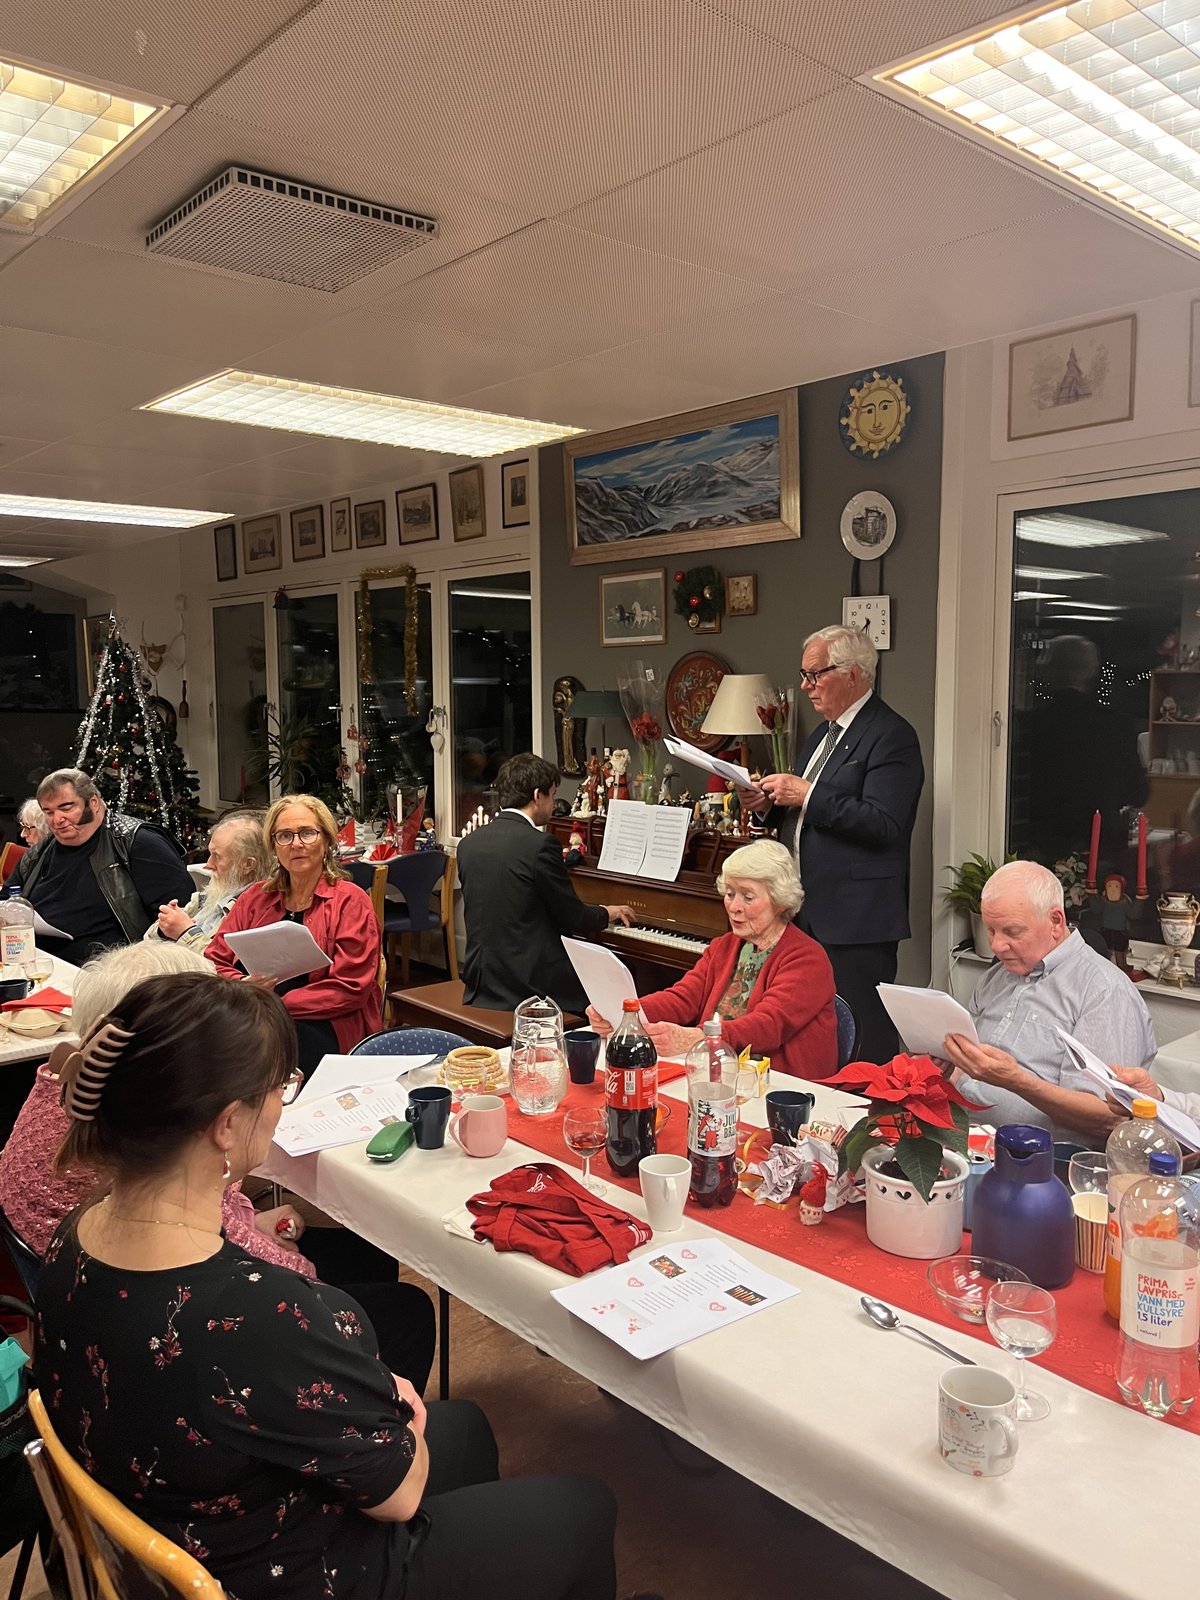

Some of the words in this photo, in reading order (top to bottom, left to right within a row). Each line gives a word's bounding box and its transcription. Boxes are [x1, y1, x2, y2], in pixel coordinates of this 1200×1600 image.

[1137, 1292, 1163, 1307] VANN
[1165, 1299, 1185, 1308] MED
[1137, 1301, 1184, 1318] KULLSYRE
[1150, 1315, 1173, 1326] liter
